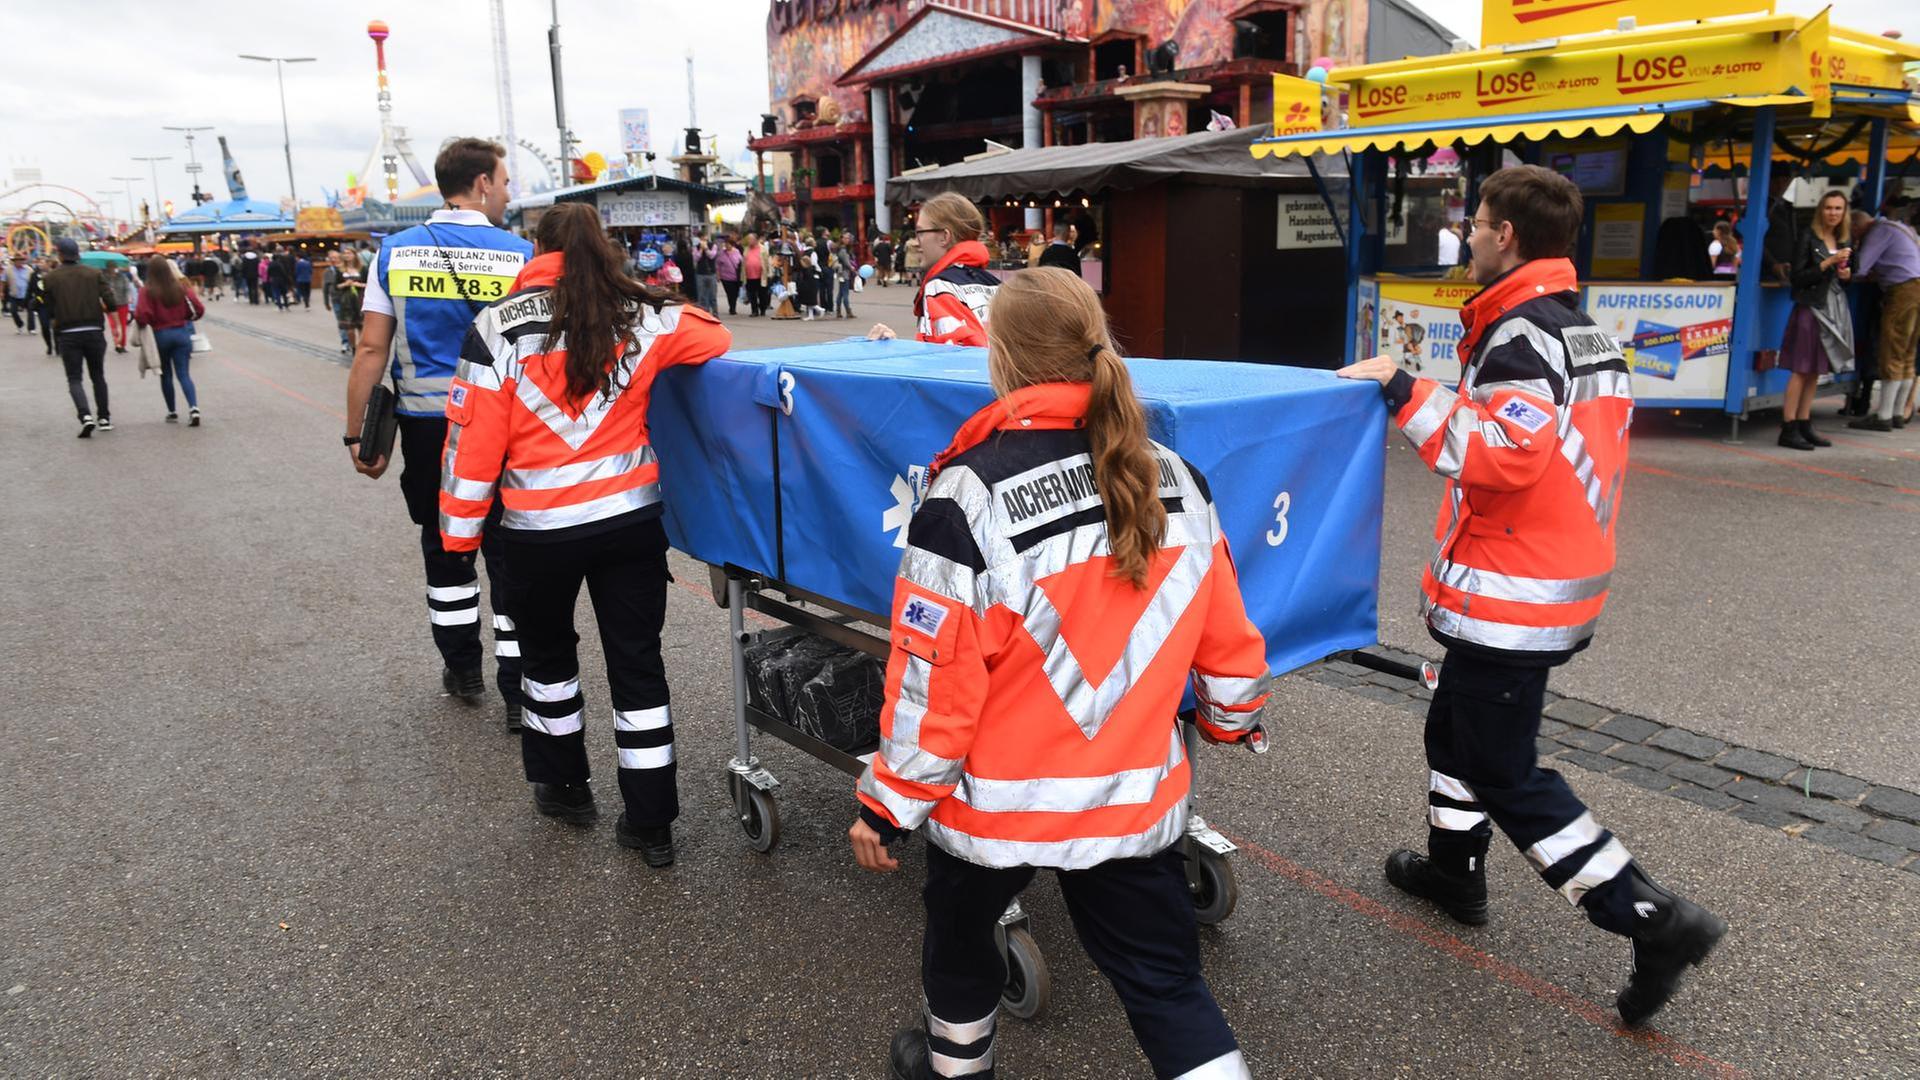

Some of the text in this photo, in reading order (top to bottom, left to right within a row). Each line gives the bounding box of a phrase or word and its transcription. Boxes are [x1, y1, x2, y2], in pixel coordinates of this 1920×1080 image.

[1615, 53, 1763, 84] Lose VON LOTTO
[1829, 56, 1846, 79] se
[1476, 69, 1537, 97] Lose
[1569, 76, 1600, 88] LOTTO
[1356, 83, 1408, 109] Lose
[1435, 91, 1462, 101] LOTTO
[601, 201, 687, 214] OKTOBERFEST
[612, 212, 677, 224] SOUVRS
[395, 248, 430, 258] AICHER
[488, 253, 520, 264] UNION
[457, 261, 494, 273] Service
[408, 275, 445, 293] RM
[1446, 289, 1477, 298] LOTTO
[1597, 293, 1723, 310] AUFREISSGAUDI
[500, 299, 538, 326] AICHER
[1428, 322, 1463, 341] HIER
[1686, 325, 1730, 341] EXTRA
[1431, 342, 1454, 360] DIE
[780, 371, 796, 417] 3
[1001, 471, 1070, 525] AICHER
[1266, 491, 1291, 547] 3
